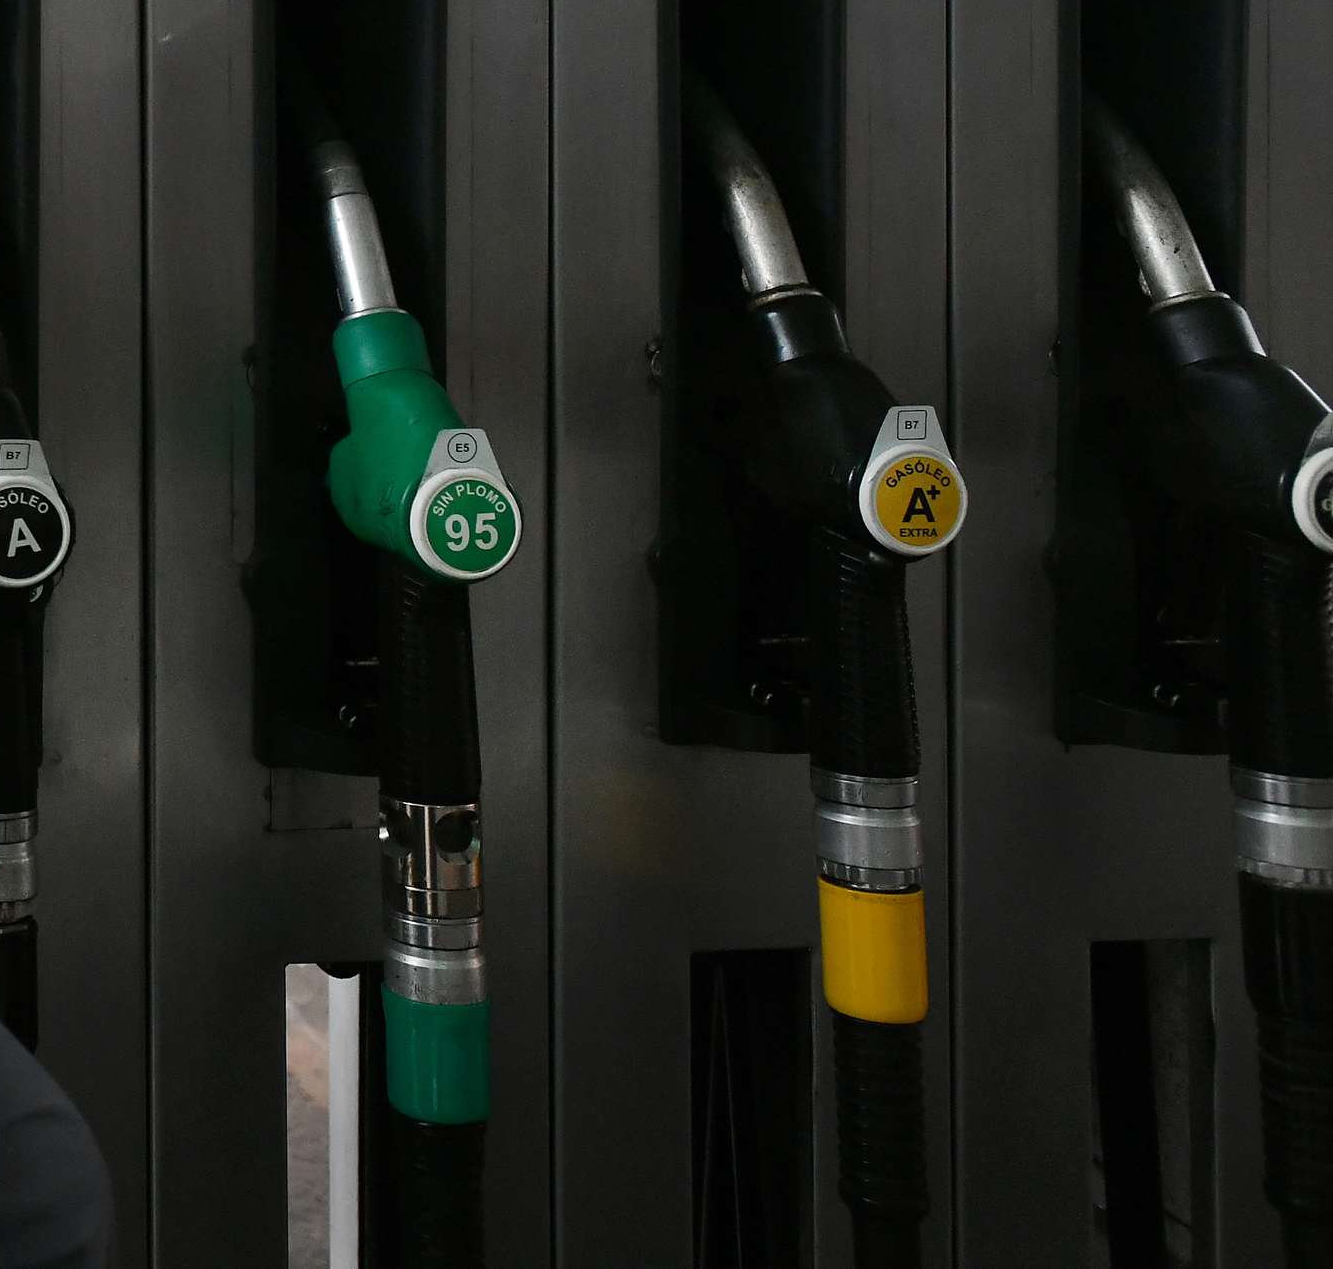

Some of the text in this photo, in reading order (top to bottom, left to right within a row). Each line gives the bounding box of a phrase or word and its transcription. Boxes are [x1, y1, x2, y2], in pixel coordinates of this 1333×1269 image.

[904, 420, 920, 430] B7
[5, 451, 22, 460] B7
[455, 443, 470, 453] E5
[885, 459, 951, 489] GASÓLEO
[432, 482, 507, 517] SIN PLOMO
[6, 517, 42, 558] A
[444, 512, 499, 552] 95
[899, 528, 939, 538] EXTRA
